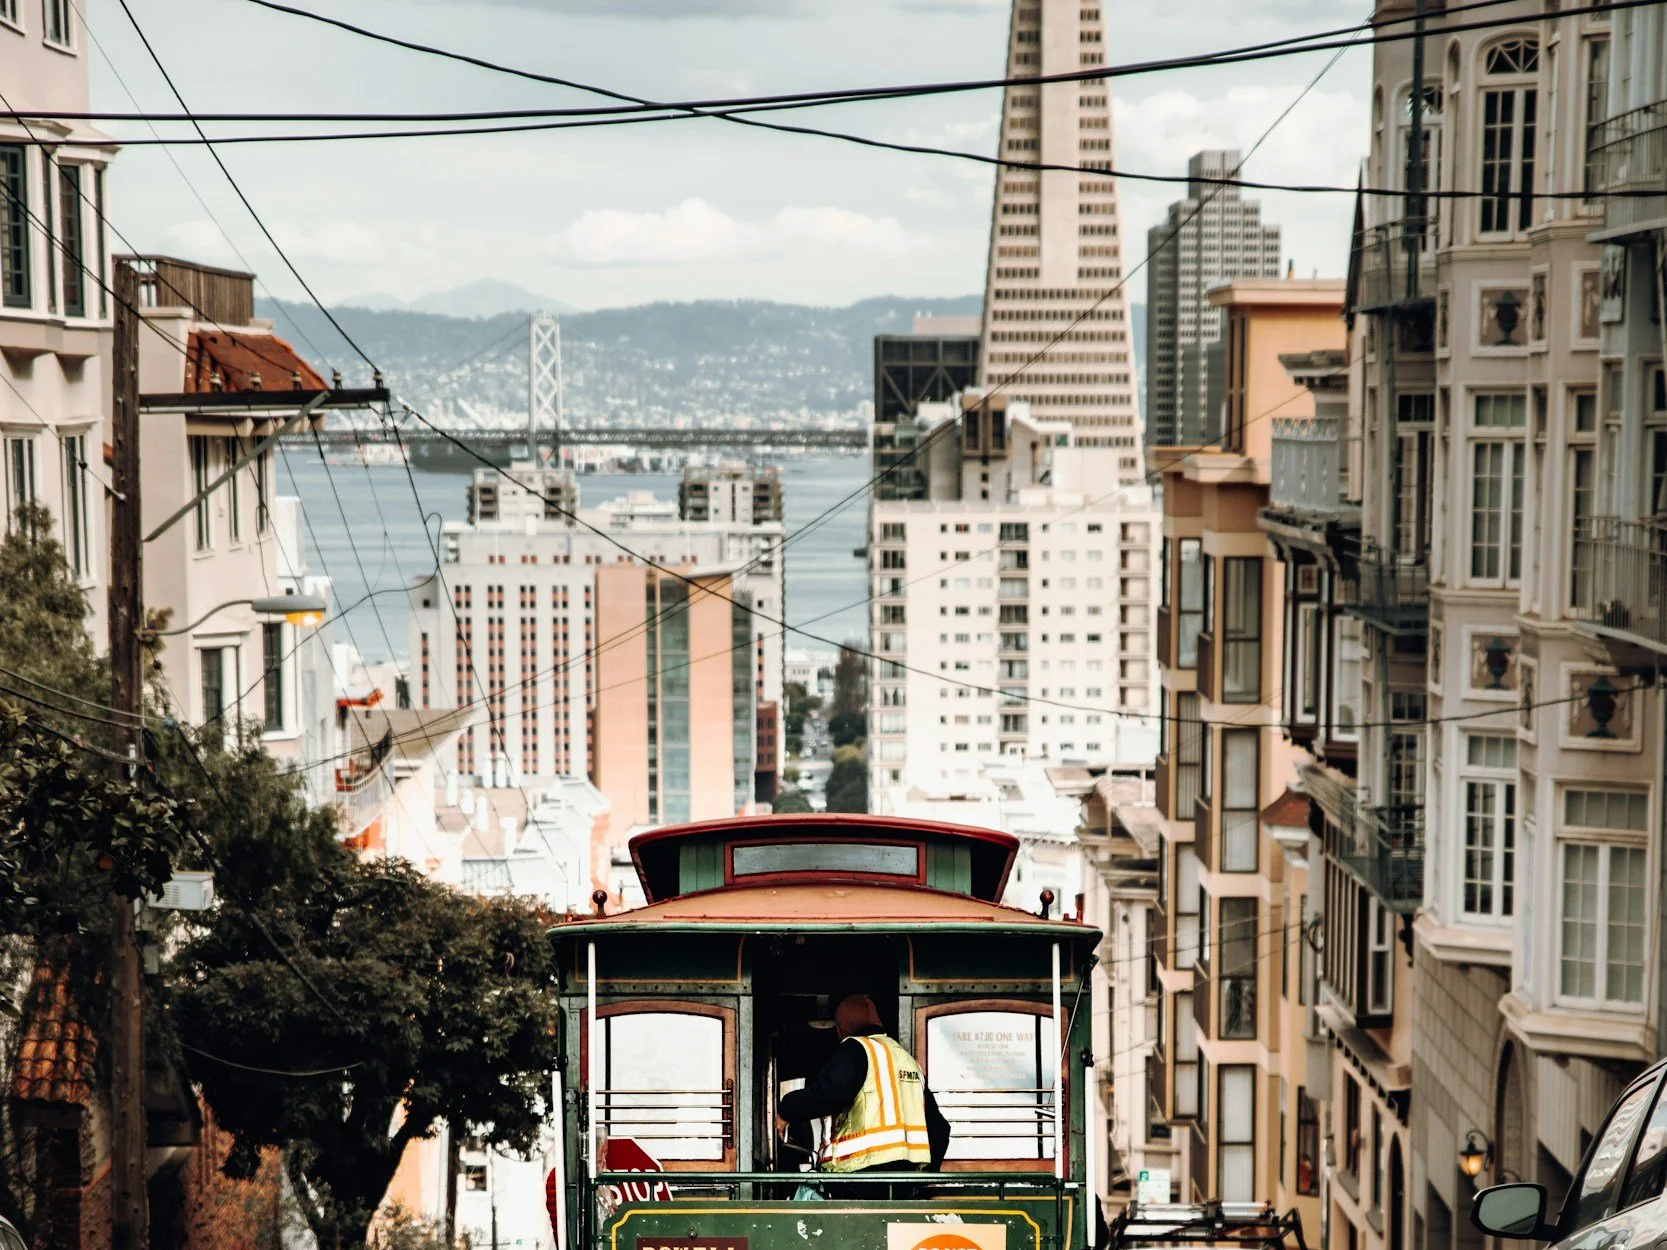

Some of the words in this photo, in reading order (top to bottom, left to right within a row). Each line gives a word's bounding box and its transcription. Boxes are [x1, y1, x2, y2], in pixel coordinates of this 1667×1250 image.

[996, 1032, 1012, 1041] ONE
[1016, 1032, 1034, 1041] WAY
[899, 1070, 920, 1080] SFMTA
